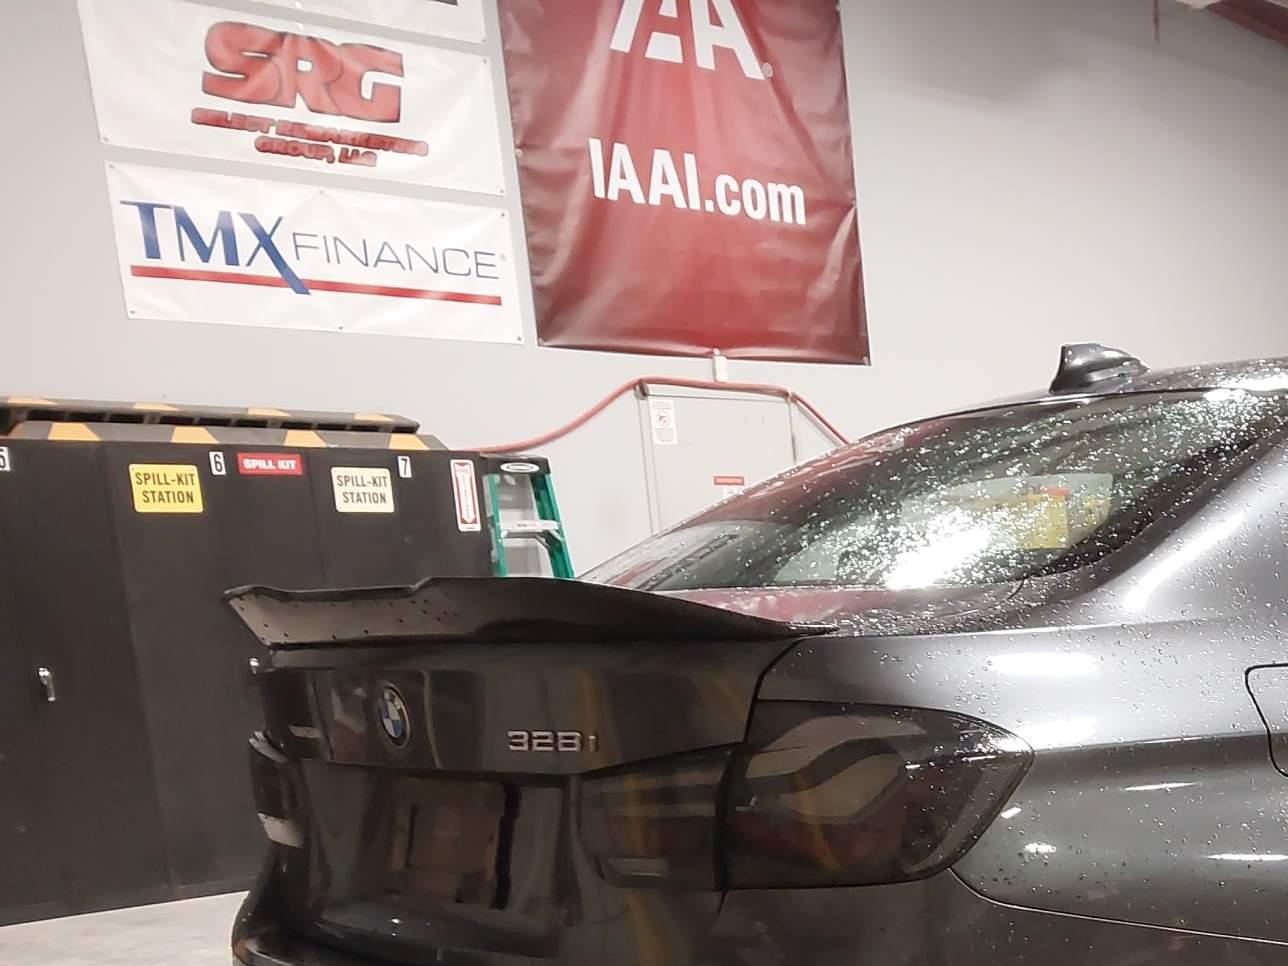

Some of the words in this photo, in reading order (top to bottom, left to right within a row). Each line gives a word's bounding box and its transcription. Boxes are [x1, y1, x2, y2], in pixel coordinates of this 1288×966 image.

[202, 21, 404, 123] SRG
[588, 137, 806, 225] IAAI.com
[119, 200, 310, 295] TMX
[291, 232, 500, 280] FINANCE
[213, 453, 223, 473] 6
[243, 458, 276, 469] SPILL
[278, 460, 297, 470] KIT
[401, 458, 409, 476] 7
[135, 471, 196, 487] SPILL-KIT
[336, 475, 388, 488] SPILL-KIT
[142, 490, 194, 504] STATION
[342, 491, 387, 504] STATION
[506, 730, 597, 752] 328i
